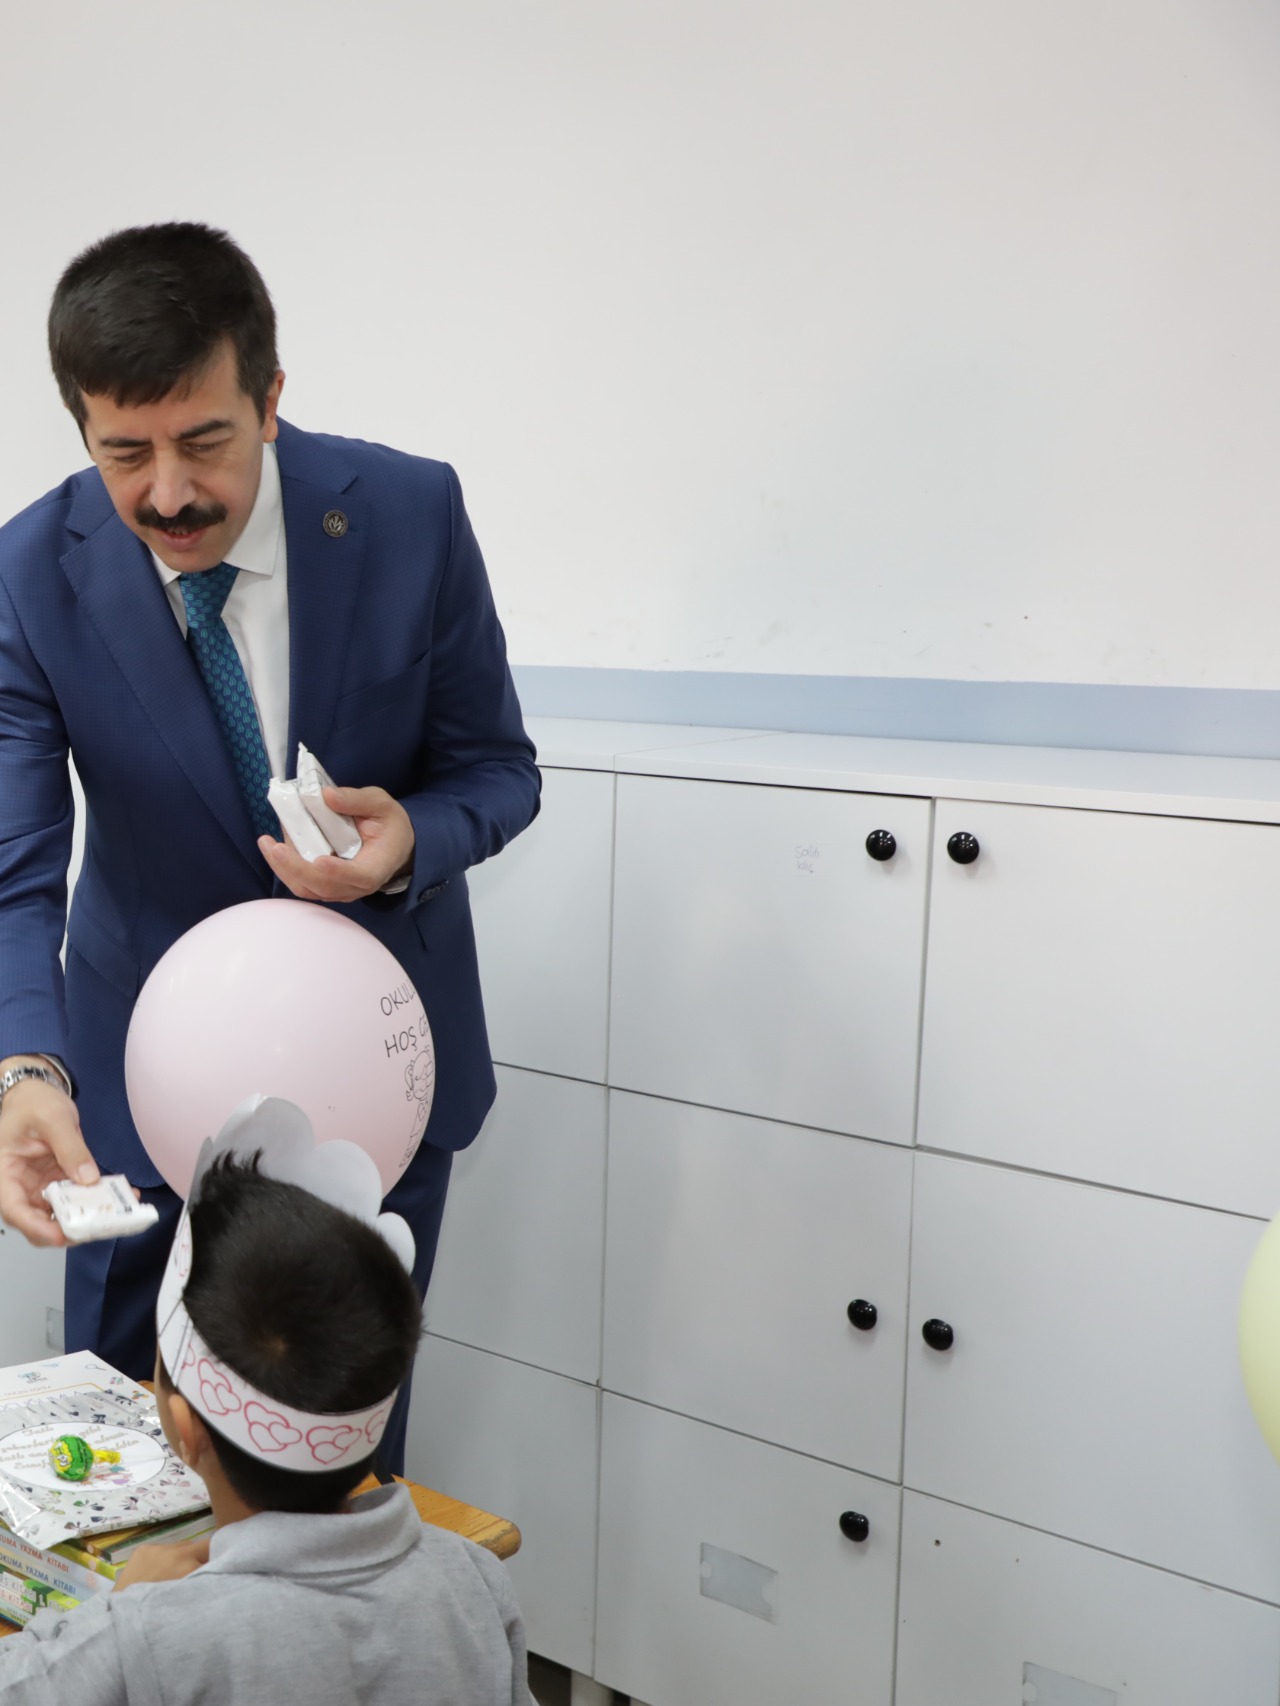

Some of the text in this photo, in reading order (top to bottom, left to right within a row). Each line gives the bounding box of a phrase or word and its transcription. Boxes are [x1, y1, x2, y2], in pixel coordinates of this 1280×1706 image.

[384, 1026, 417, 1058] HOŞ
[19, 1543, 43, 1561] YAZMA
[47, 1553, 69, 1573] KİTABI
[11, 1579, 37, 1602] KİTABI
[25, 1564, 49, 1582] YAZMA
[53, 1577, 76, 1595] KİTABI
[8, 1593, 33, 1614] KİTABI
